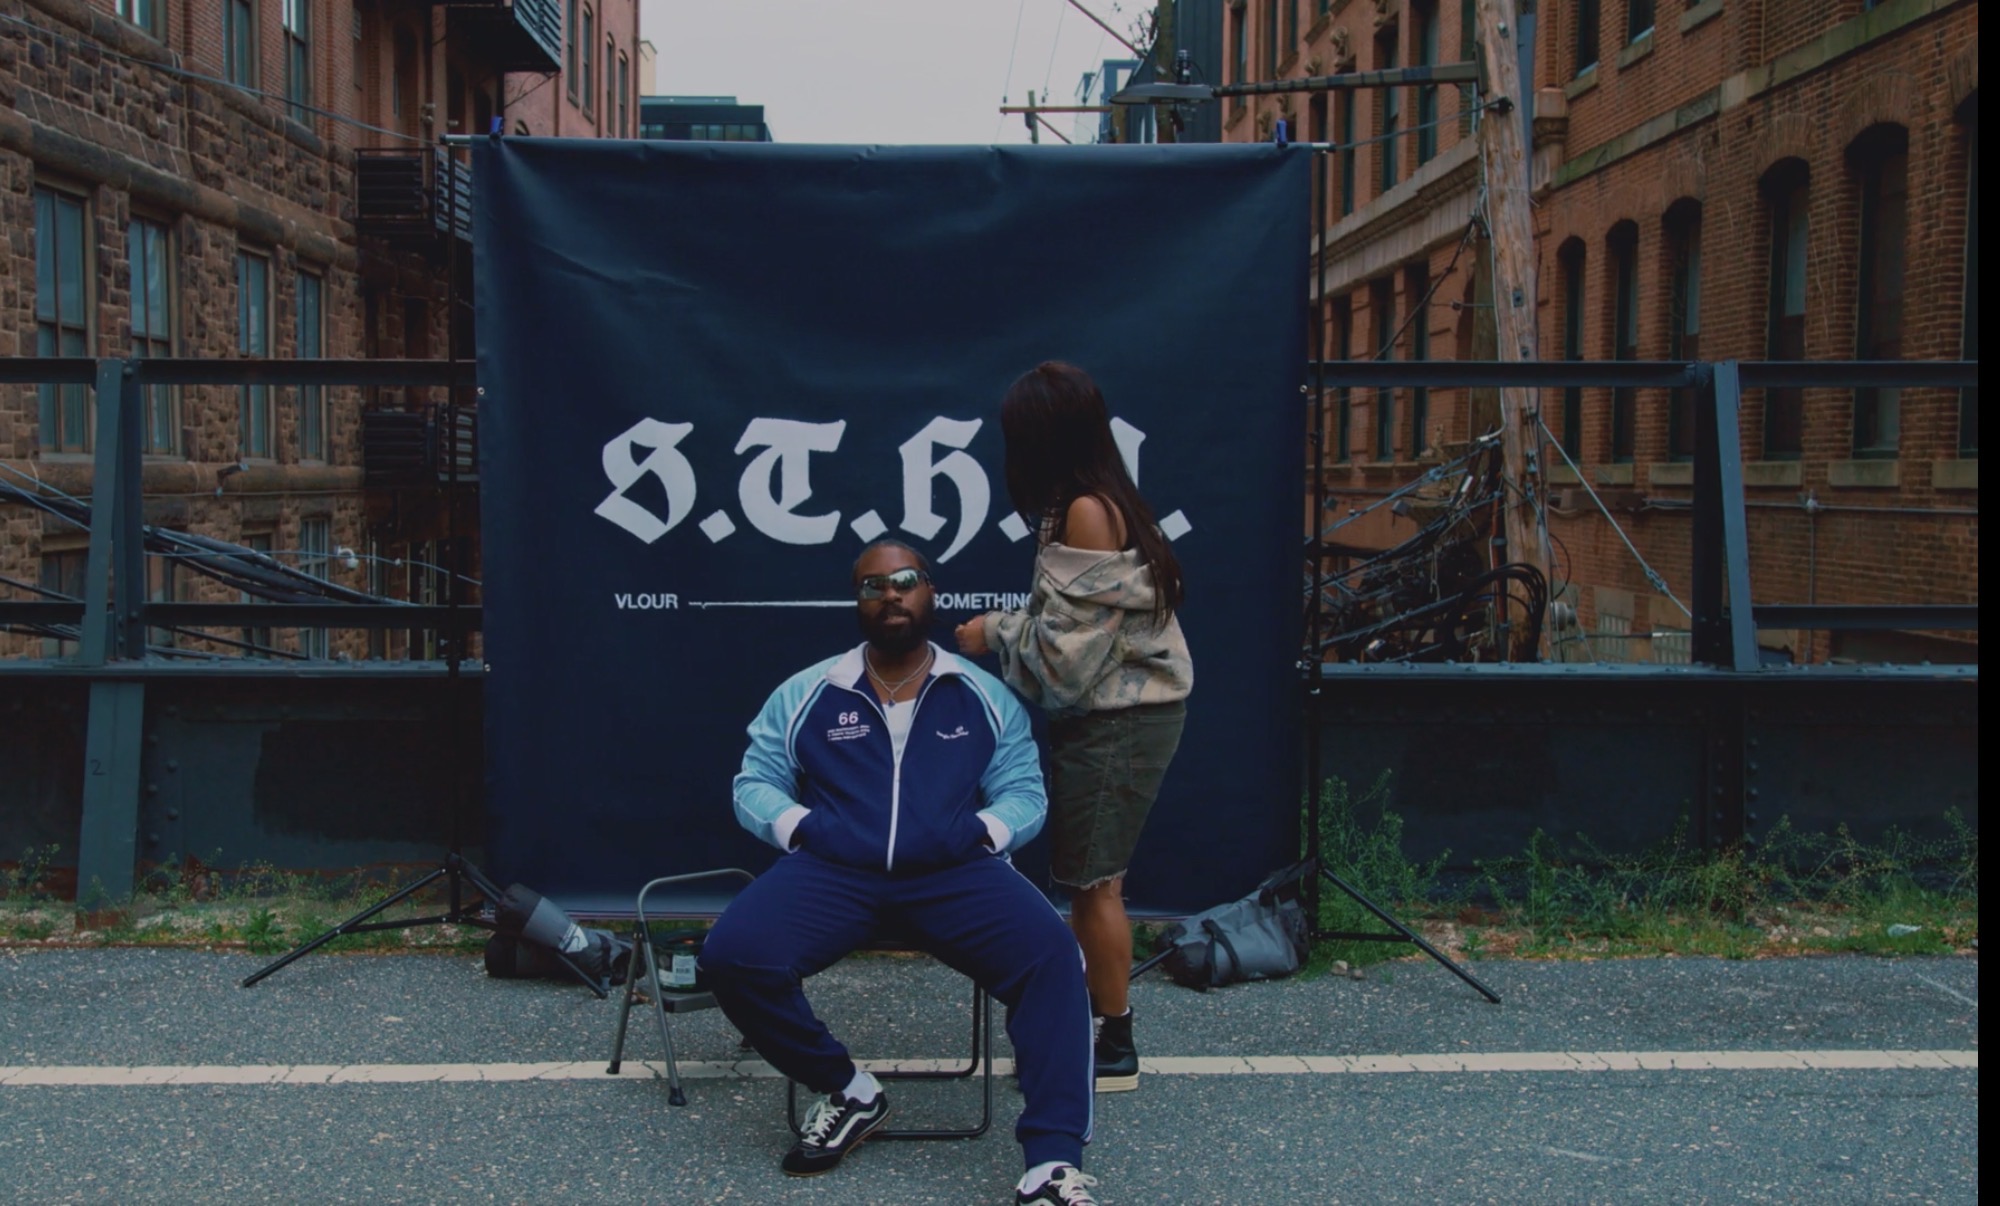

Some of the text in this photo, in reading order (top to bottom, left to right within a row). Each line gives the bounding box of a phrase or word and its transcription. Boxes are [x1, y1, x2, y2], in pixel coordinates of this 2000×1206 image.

[614, 593, 679, 609] VLOUR
[838, 711, 859, 726] 66
[89, 758, 106, 776] 2
